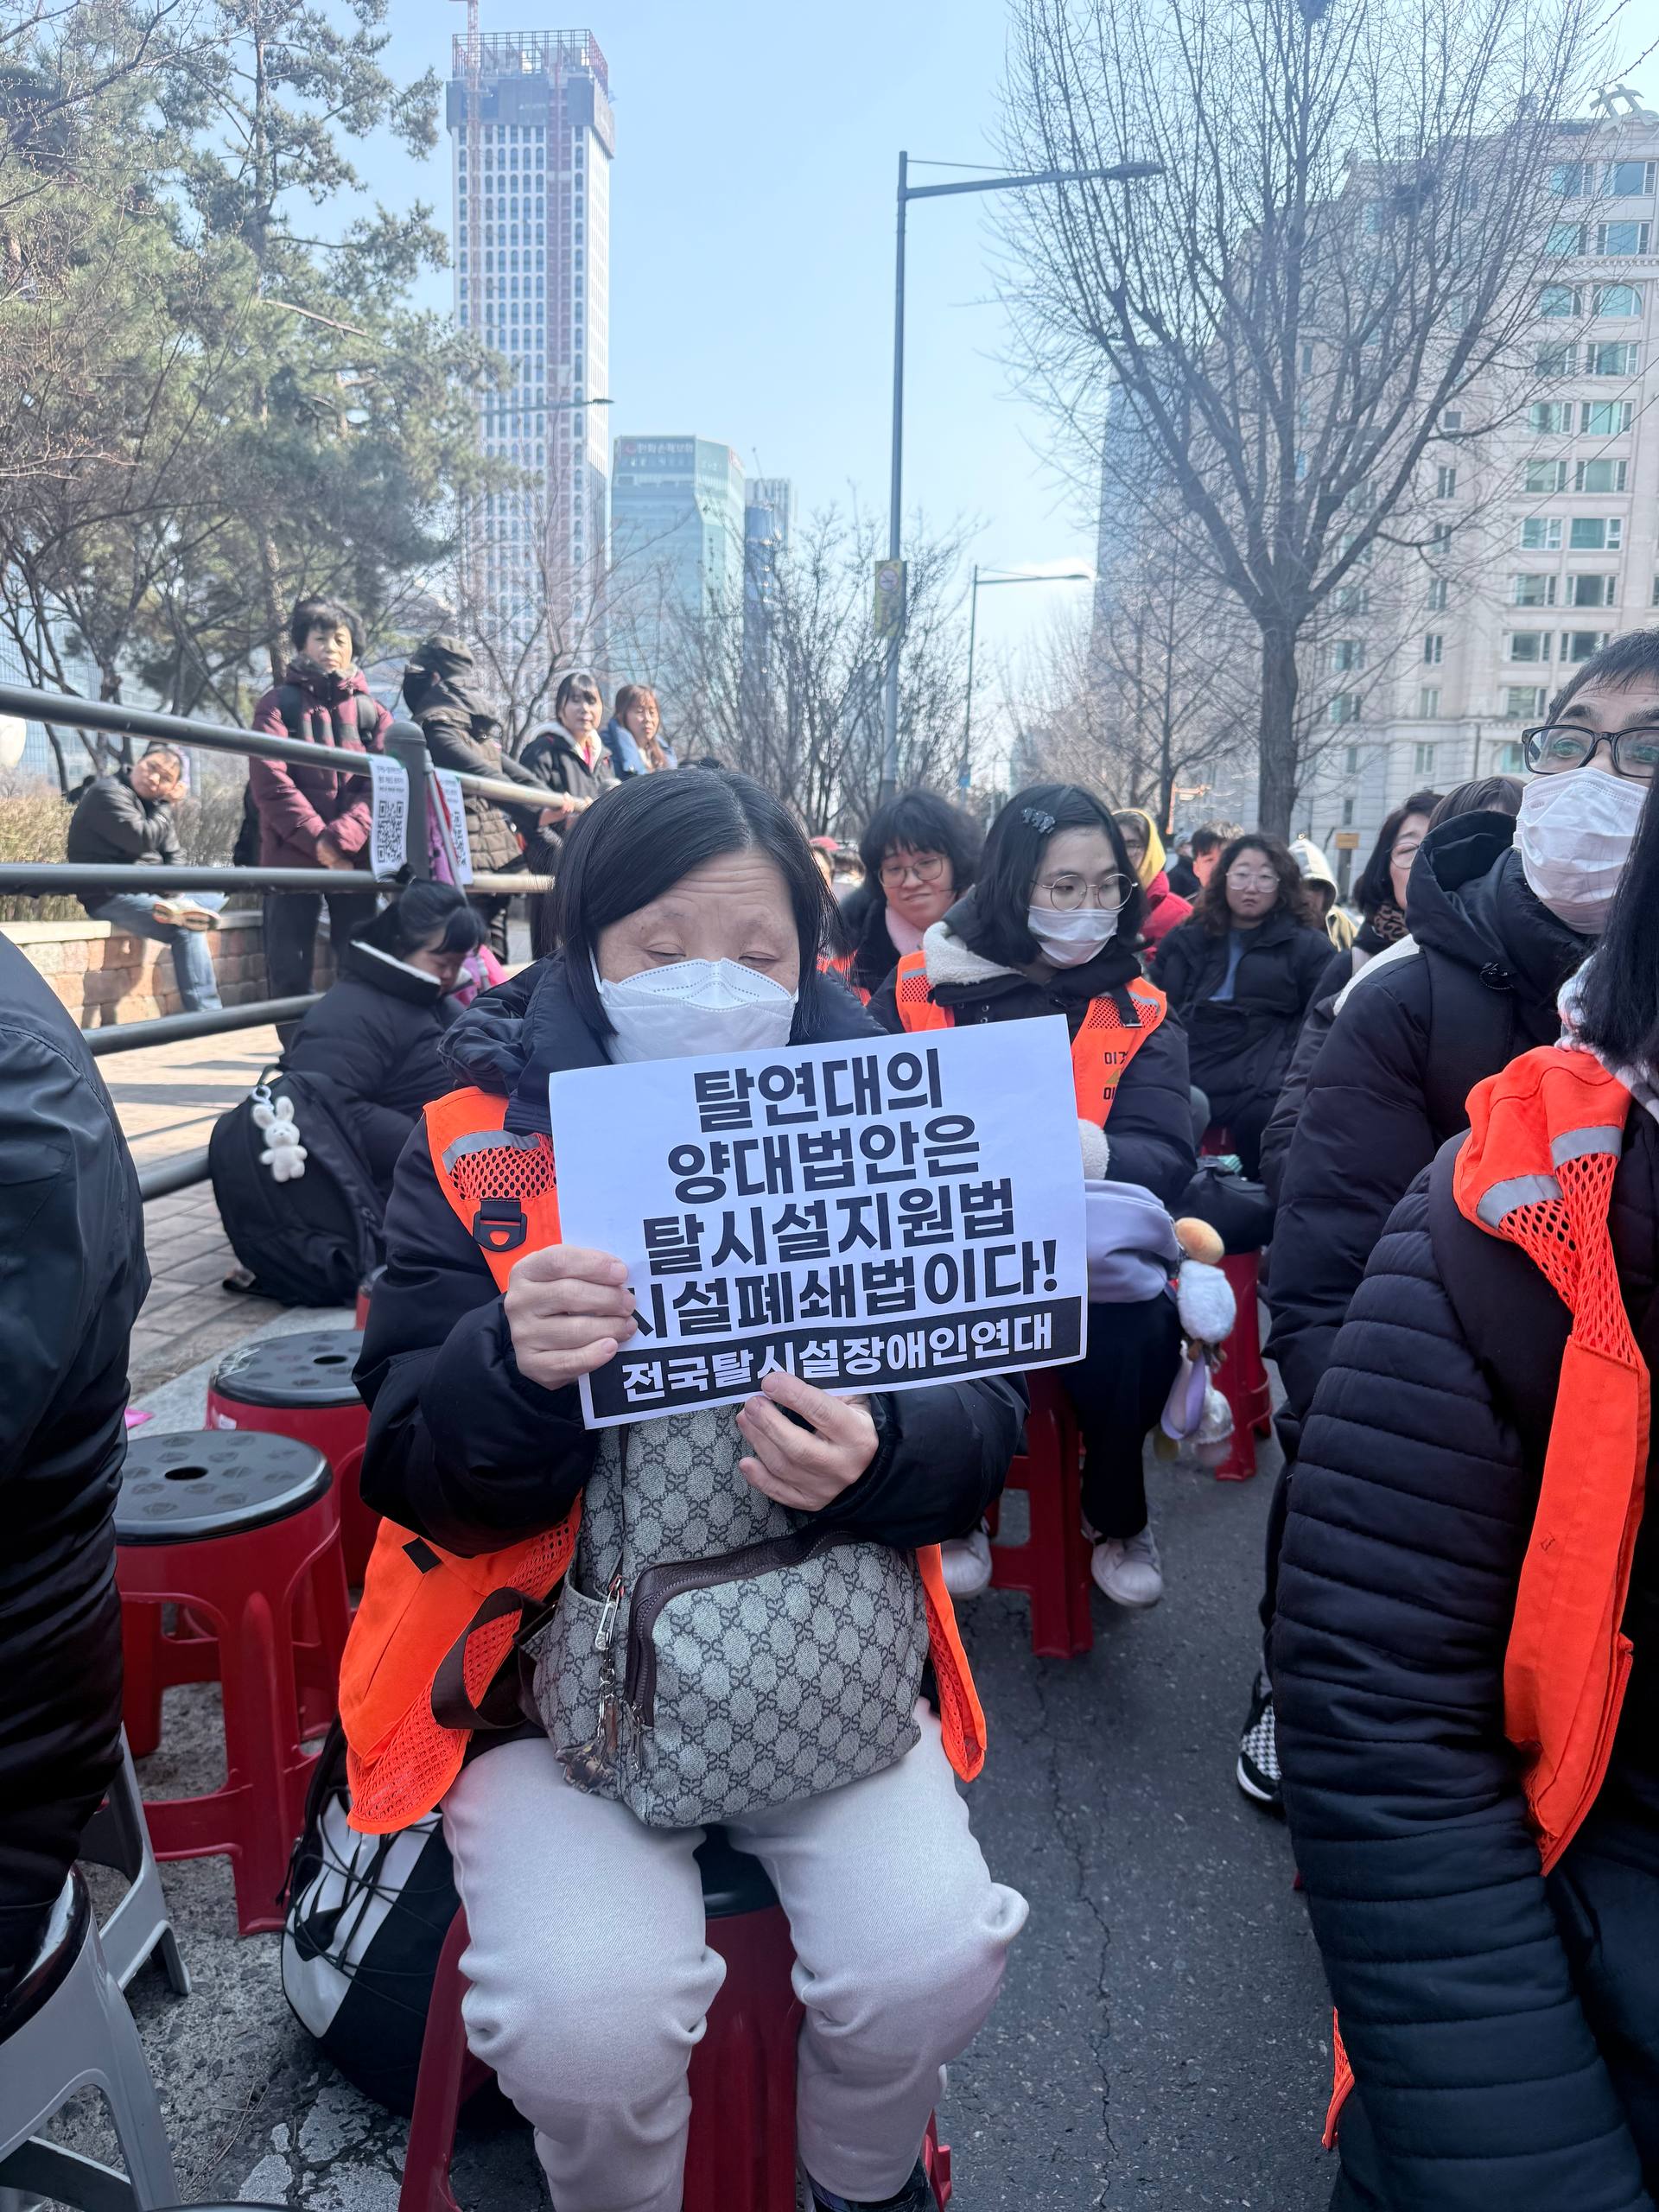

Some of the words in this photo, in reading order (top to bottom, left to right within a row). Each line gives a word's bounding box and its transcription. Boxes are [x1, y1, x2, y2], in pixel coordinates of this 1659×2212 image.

[693, 1048, 943, 1133] 탈연대의
[668, 1115, 980, 1204] 양대법안은
[643, 1178, 1014, 1276] 탈시설지원법
[622, 1313, 1052, 1402] 전국탈시설장애인연대
